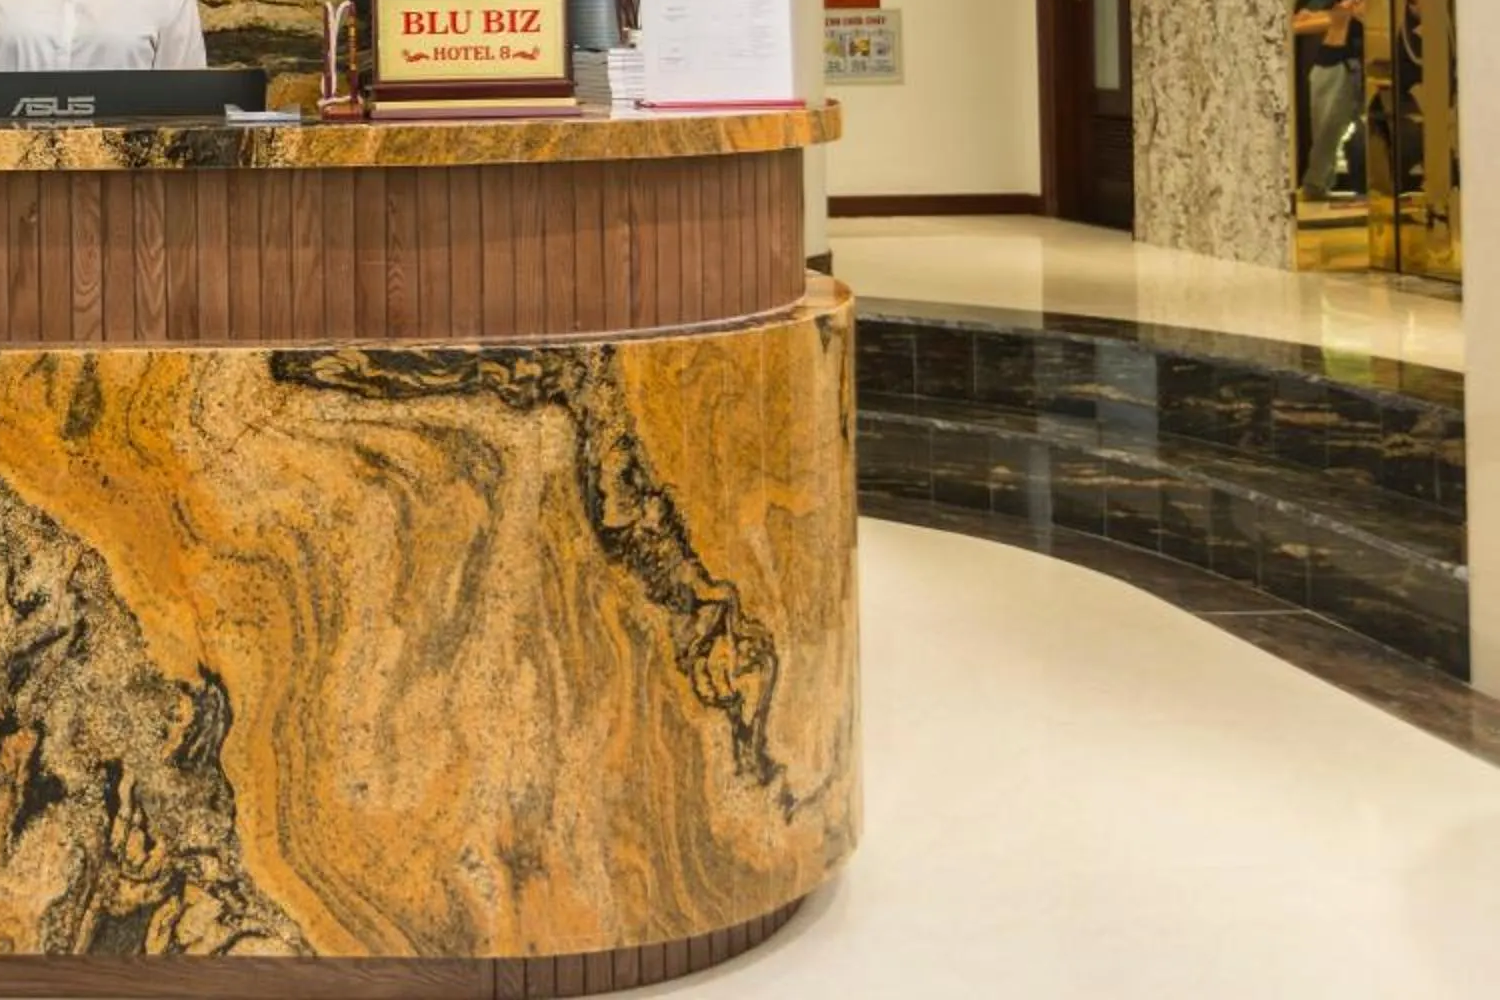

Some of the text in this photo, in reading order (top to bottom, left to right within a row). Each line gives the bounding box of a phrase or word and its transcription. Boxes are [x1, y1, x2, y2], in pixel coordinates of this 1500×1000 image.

[402, 8, 541, 35] BLU BIZ
[432, 45, 512, 61] HOTEL 8
[11, 96, 96, 117] ASUS
